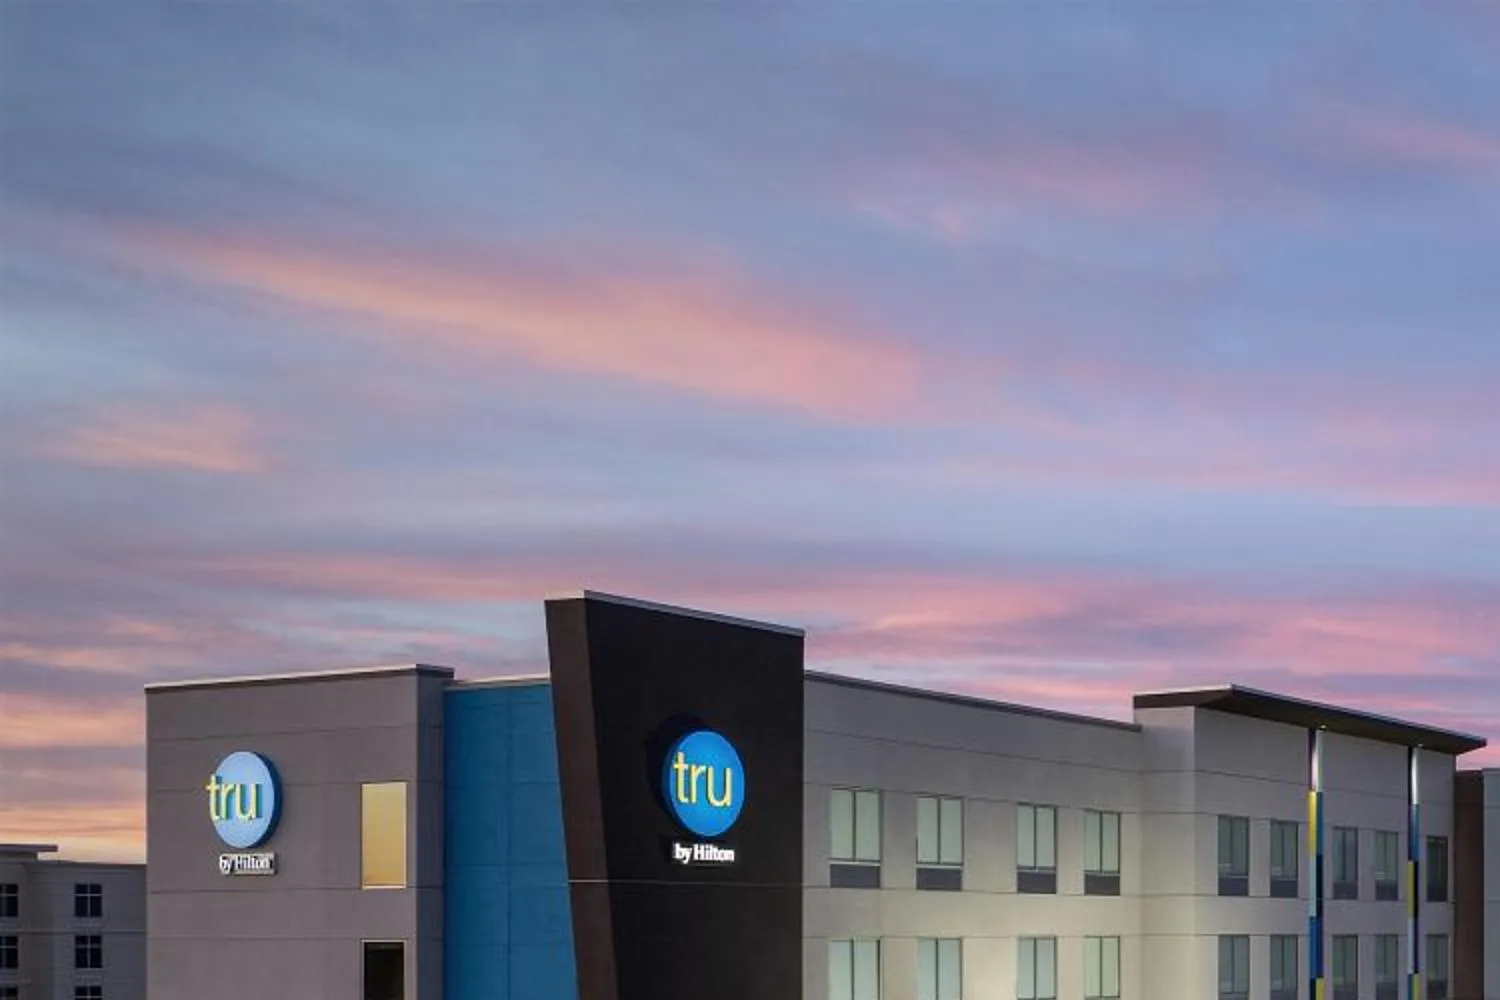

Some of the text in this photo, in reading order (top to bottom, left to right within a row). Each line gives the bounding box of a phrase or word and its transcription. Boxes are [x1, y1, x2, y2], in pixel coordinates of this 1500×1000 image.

[672, 751, 733, 807] tru
[206, 773, 262, 821] tru
[219, 854, 271, 875] by Hilton
[673, 843, 735, 864] by Hilton
